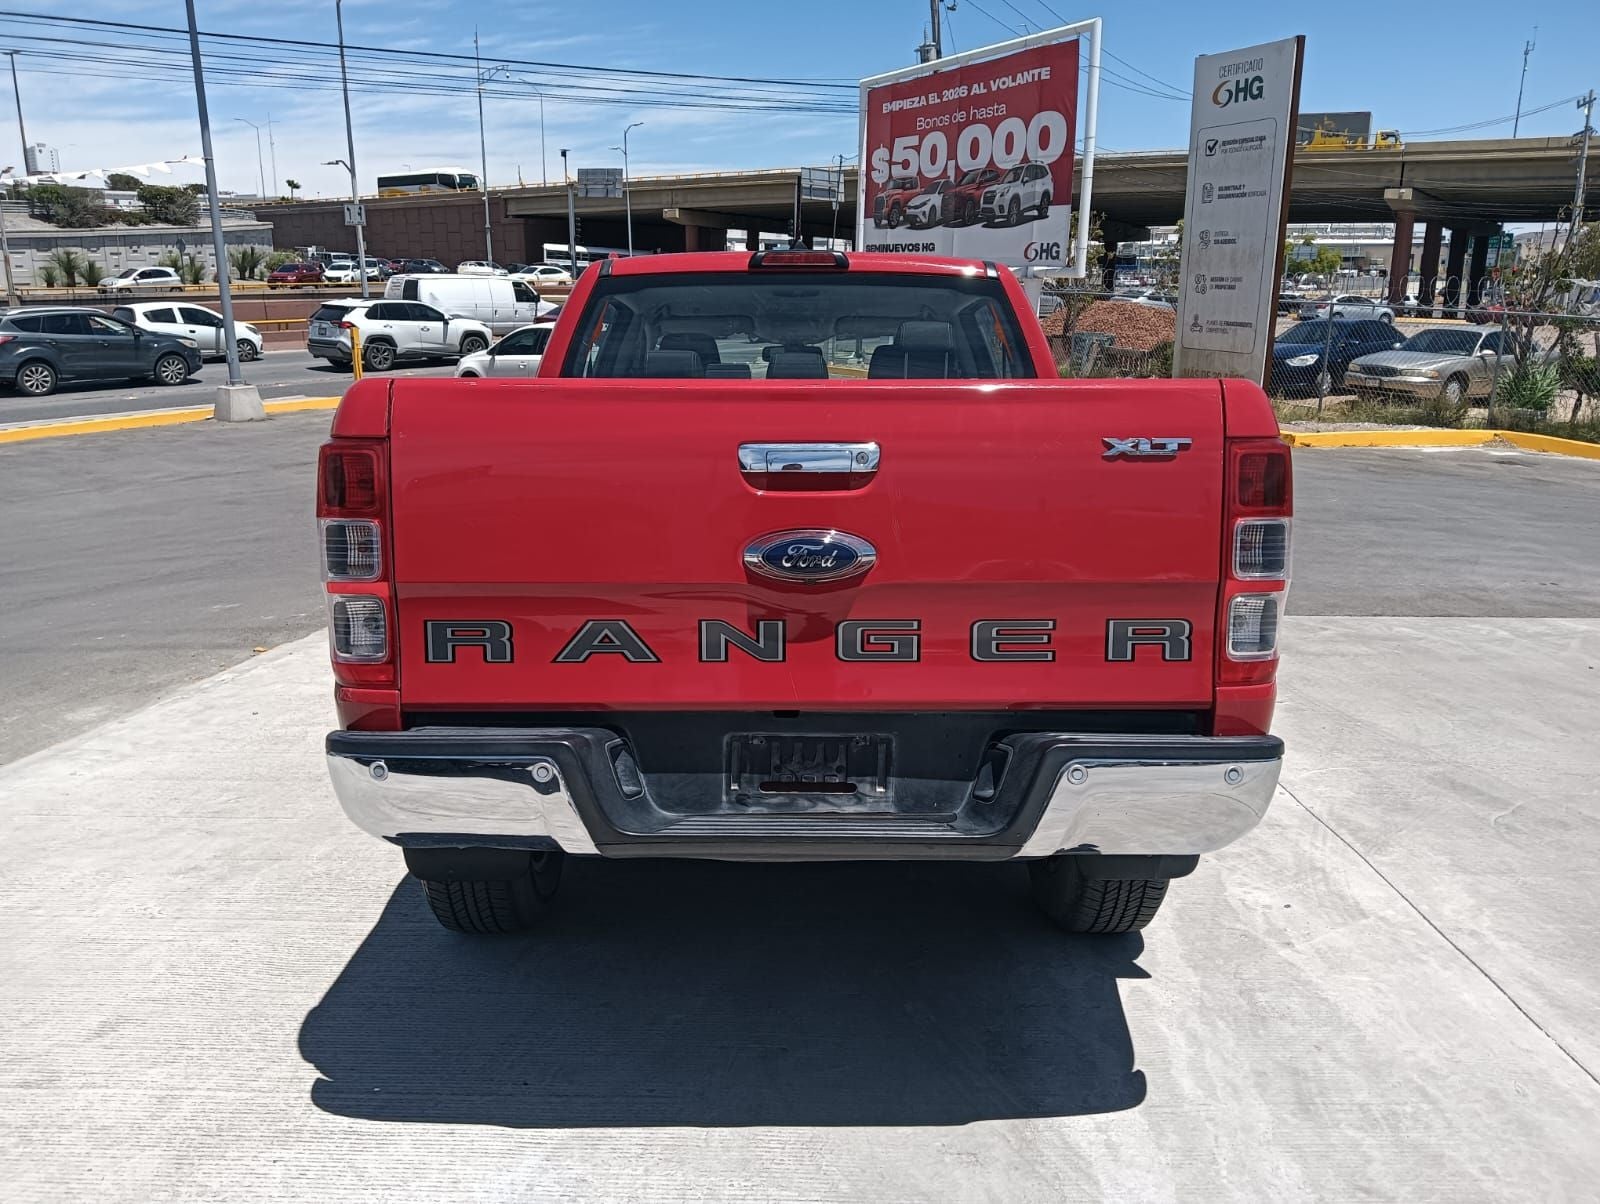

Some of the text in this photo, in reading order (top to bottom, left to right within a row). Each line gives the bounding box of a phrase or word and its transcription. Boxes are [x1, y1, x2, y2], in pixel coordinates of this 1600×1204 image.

[1218, 57, 1264, 79] CERTIFICADO
[882, 66, 1051, 114] EMPIEZA EL 2026 AL VOLANTE
[1234, 75, 1264, 103] HG
[916, 102, 1007, 131] Bonos de hasta
[871, 110, 1068, 188] $50,000
[865, 241, 936, 253] SEMINUEVOS HG
[1039, 241, 1060, 261] HG
[1101, 437, 1193, 456] XLT
[781, 544, 839, 568] Ford
[424, 618, 1192, 664] RANGER
